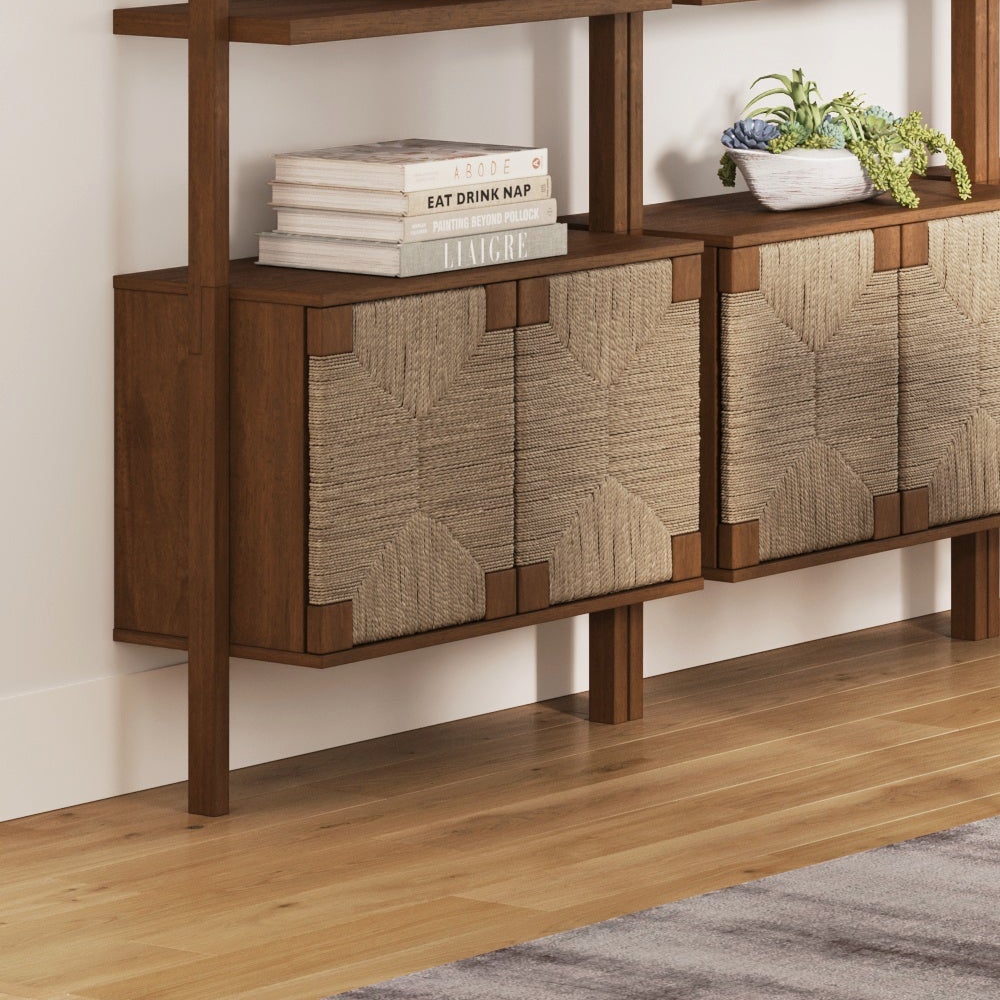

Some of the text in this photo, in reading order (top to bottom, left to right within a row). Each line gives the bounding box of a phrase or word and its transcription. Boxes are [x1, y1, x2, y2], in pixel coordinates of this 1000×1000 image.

[454, 158, 512, 180] ABODE
[427, 193, 453, 210] EAT
[457, 187, 500, 207] DRINK
[503, 183, 532, 200] NAP
[432, 216, 470, 233] PAINTING
[471, 213, 503, 227] BEYOND
[504, 207, 540, 223] POLLOCK
[444, 232, 528, 269] LIAIGRE
